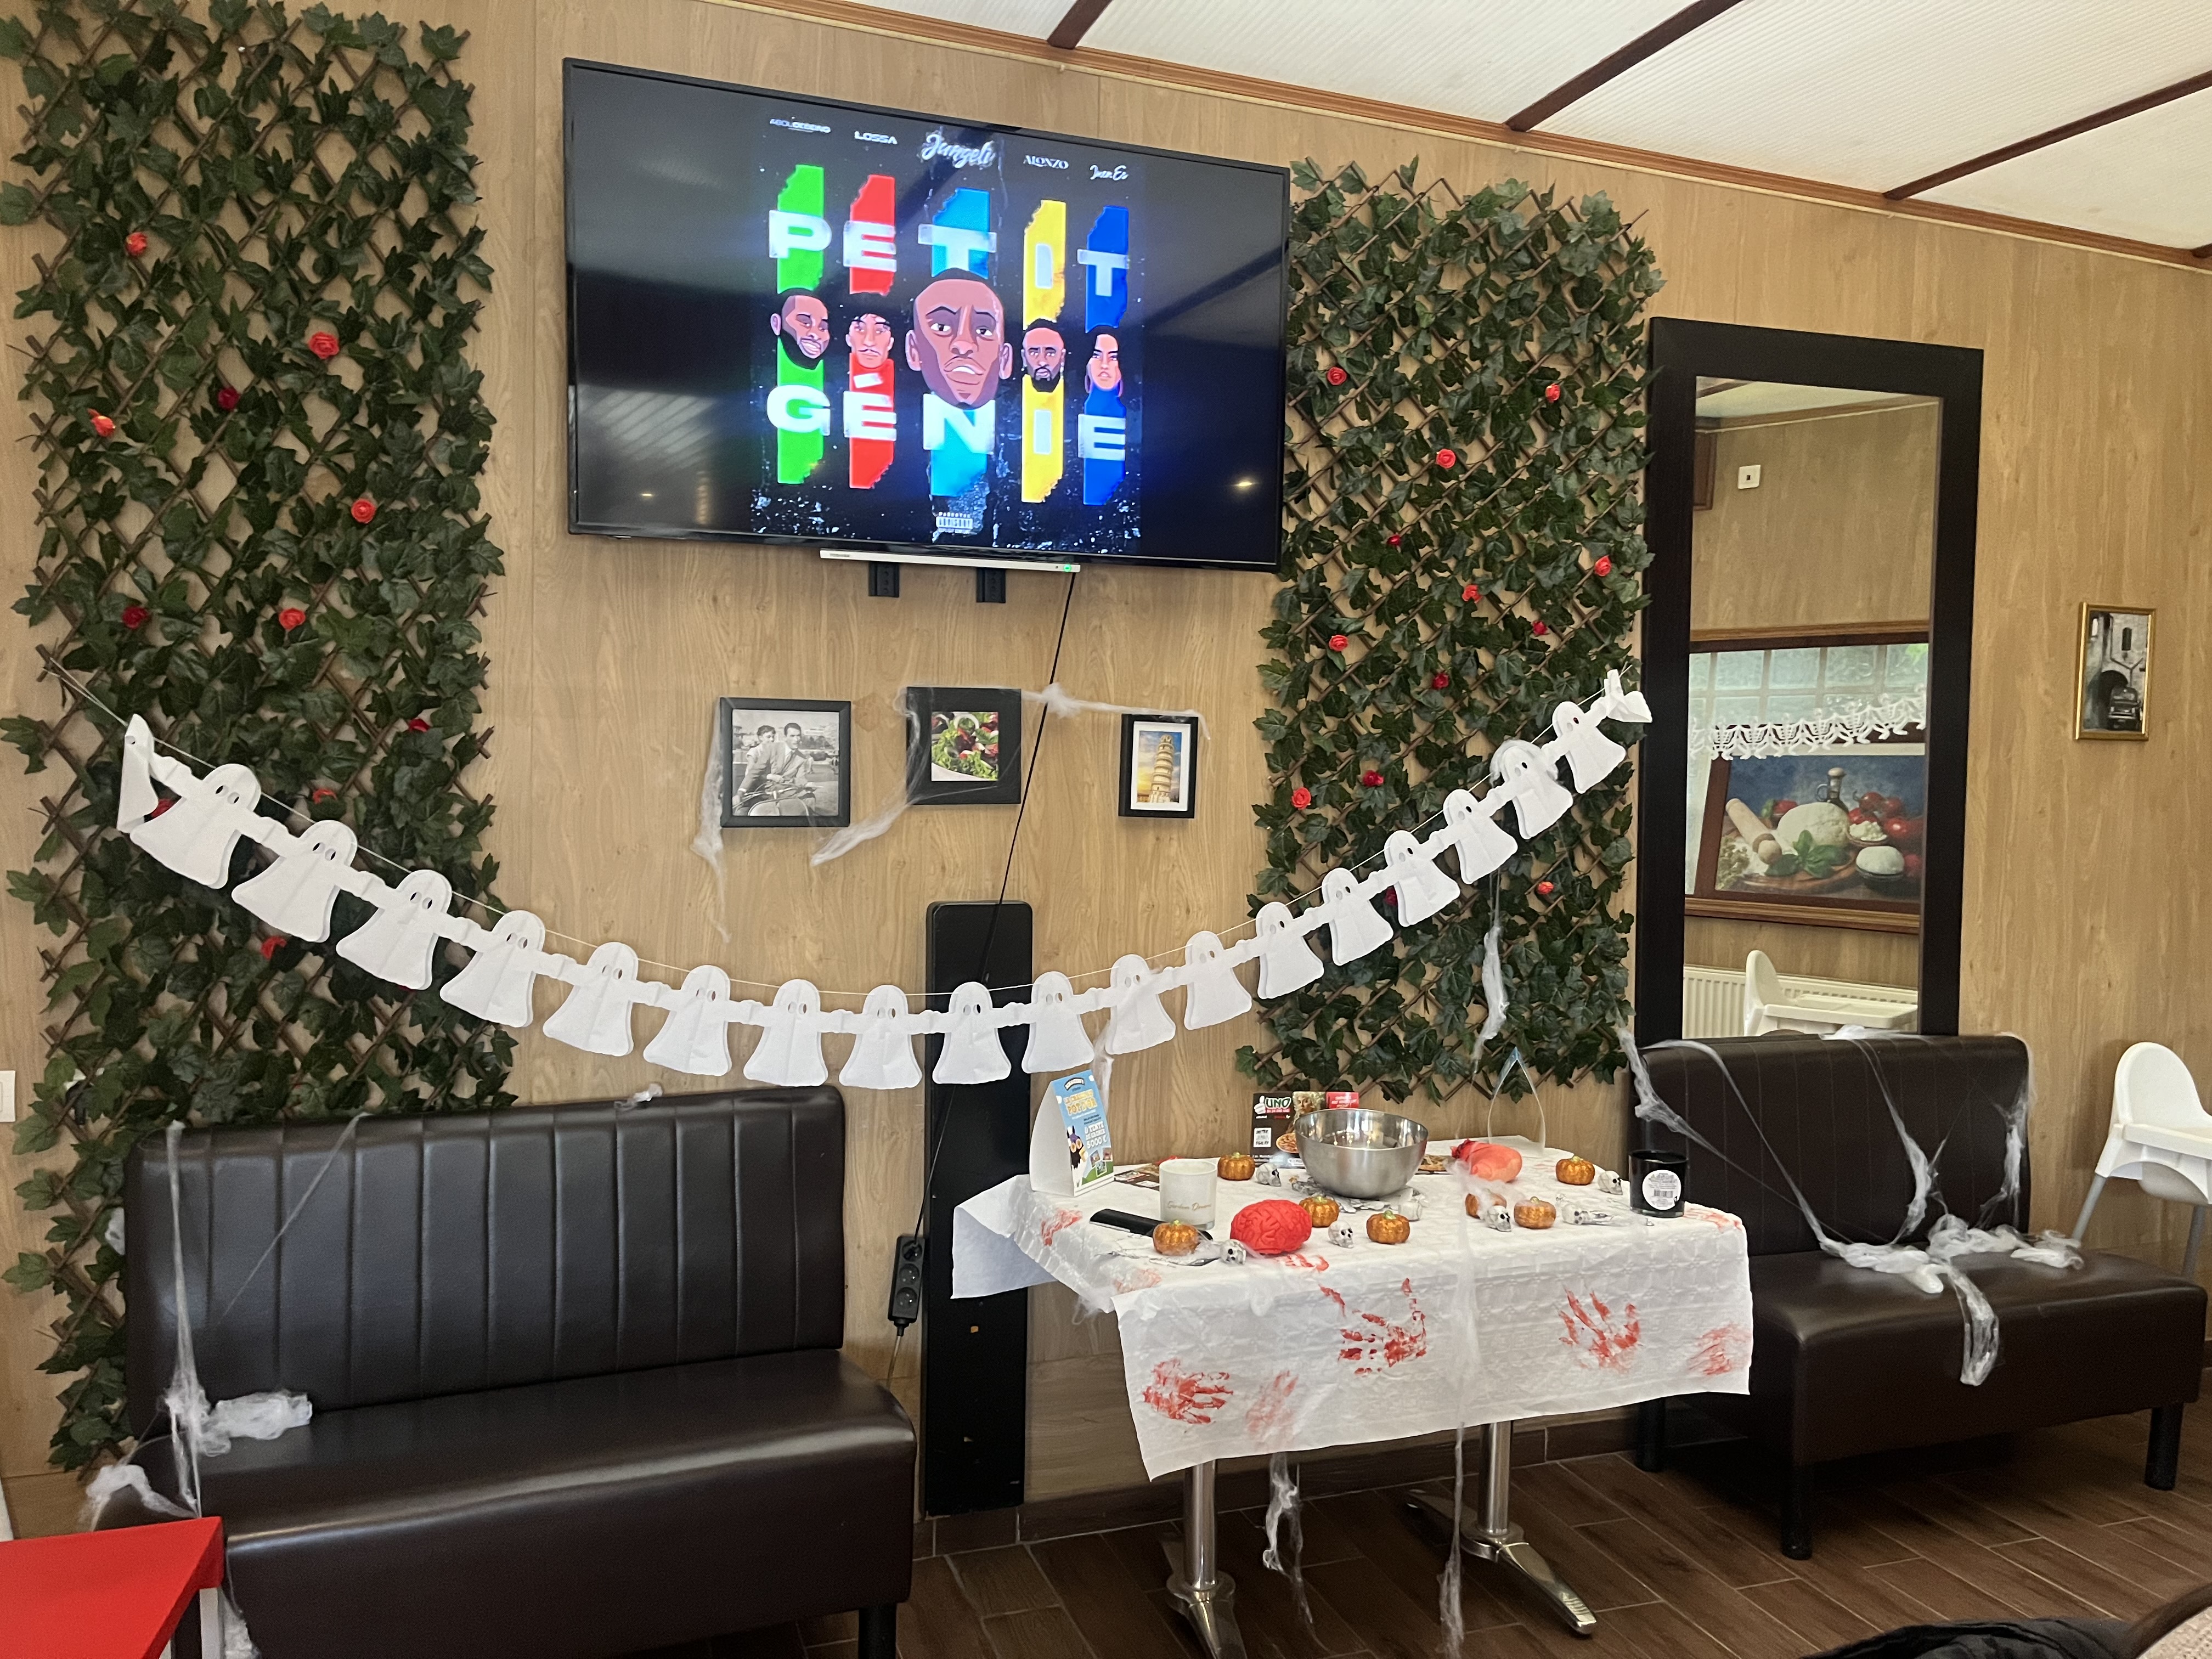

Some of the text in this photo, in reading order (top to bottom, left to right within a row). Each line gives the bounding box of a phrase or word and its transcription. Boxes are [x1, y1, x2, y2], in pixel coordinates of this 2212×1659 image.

[854, 131, 898, 145] LOSSA
[1023, 155, 1069, 170] ALONZO
[1265, 1097, 1291, 1108] UNO
[1087, 1136, 1102, 1149] 5000
